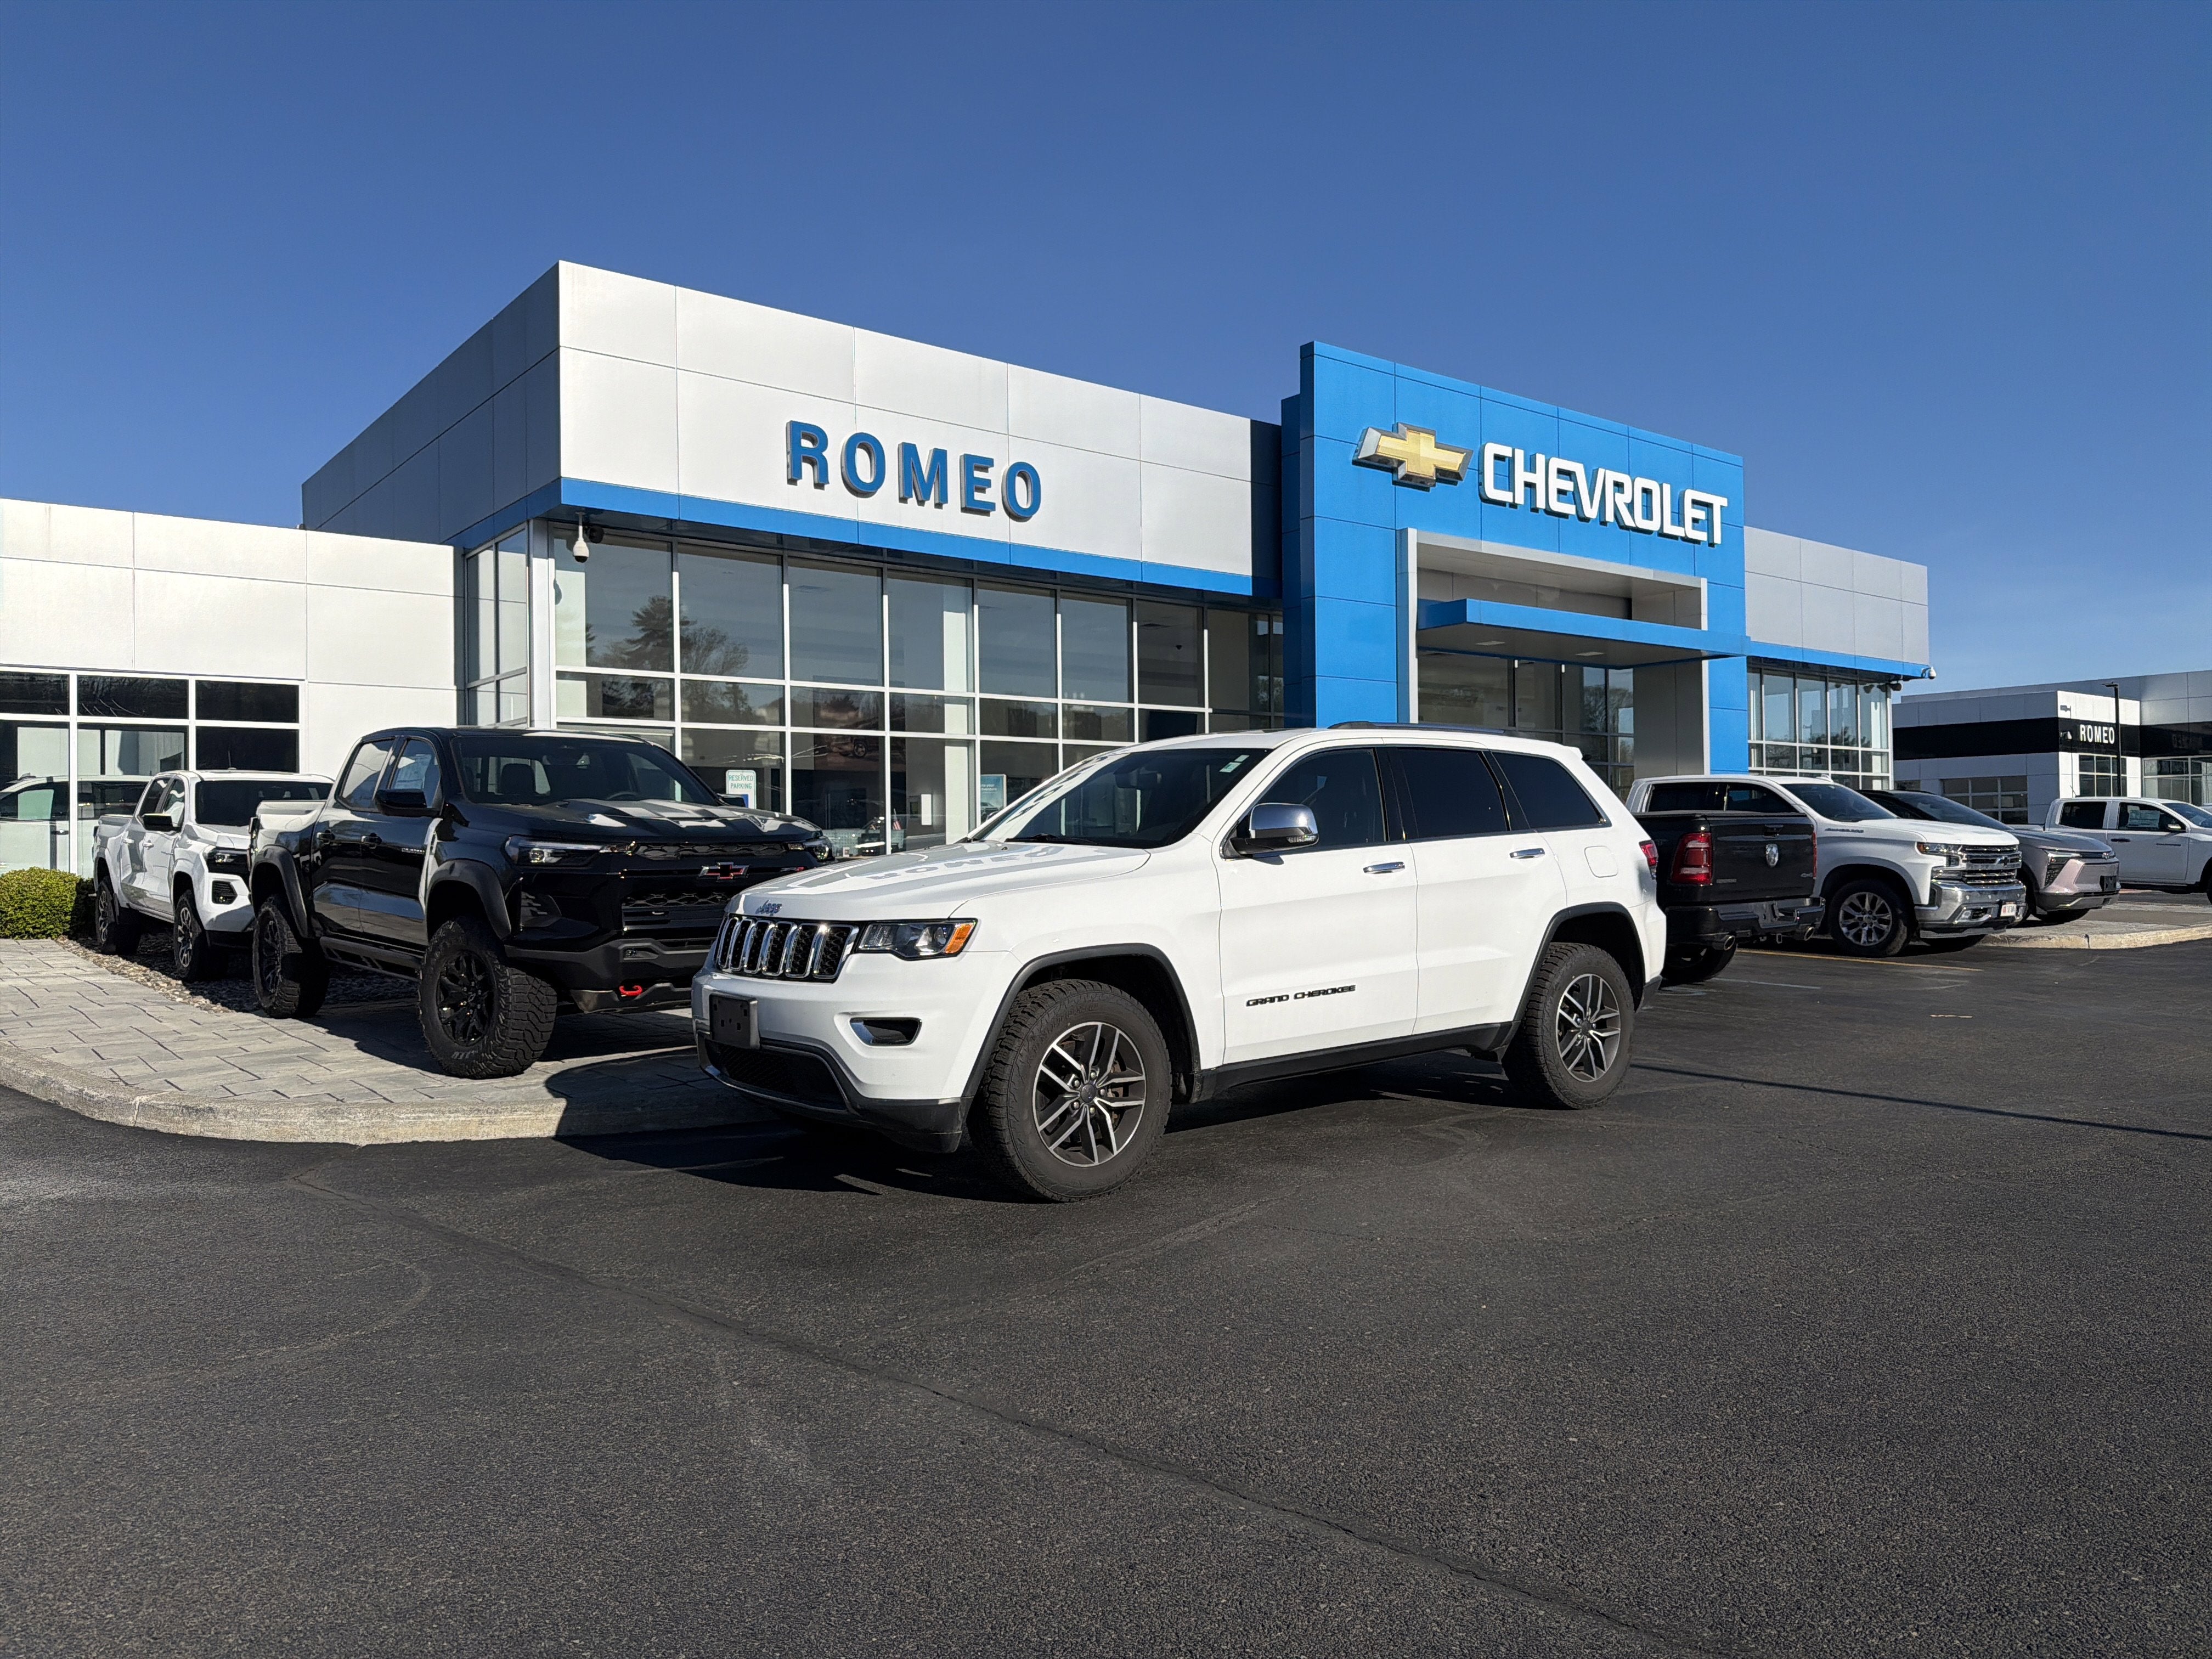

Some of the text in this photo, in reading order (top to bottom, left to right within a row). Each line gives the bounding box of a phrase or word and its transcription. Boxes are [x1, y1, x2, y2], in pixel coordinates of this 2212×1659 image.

[786, 420, 1041, 522] ROMEO
[1481, 442, 1728, 545] CHEVROLET
[2080, 724, 2115, 744] ROMEO
[1246, 985, 1356, 1007] GRAND CHEROKEE
